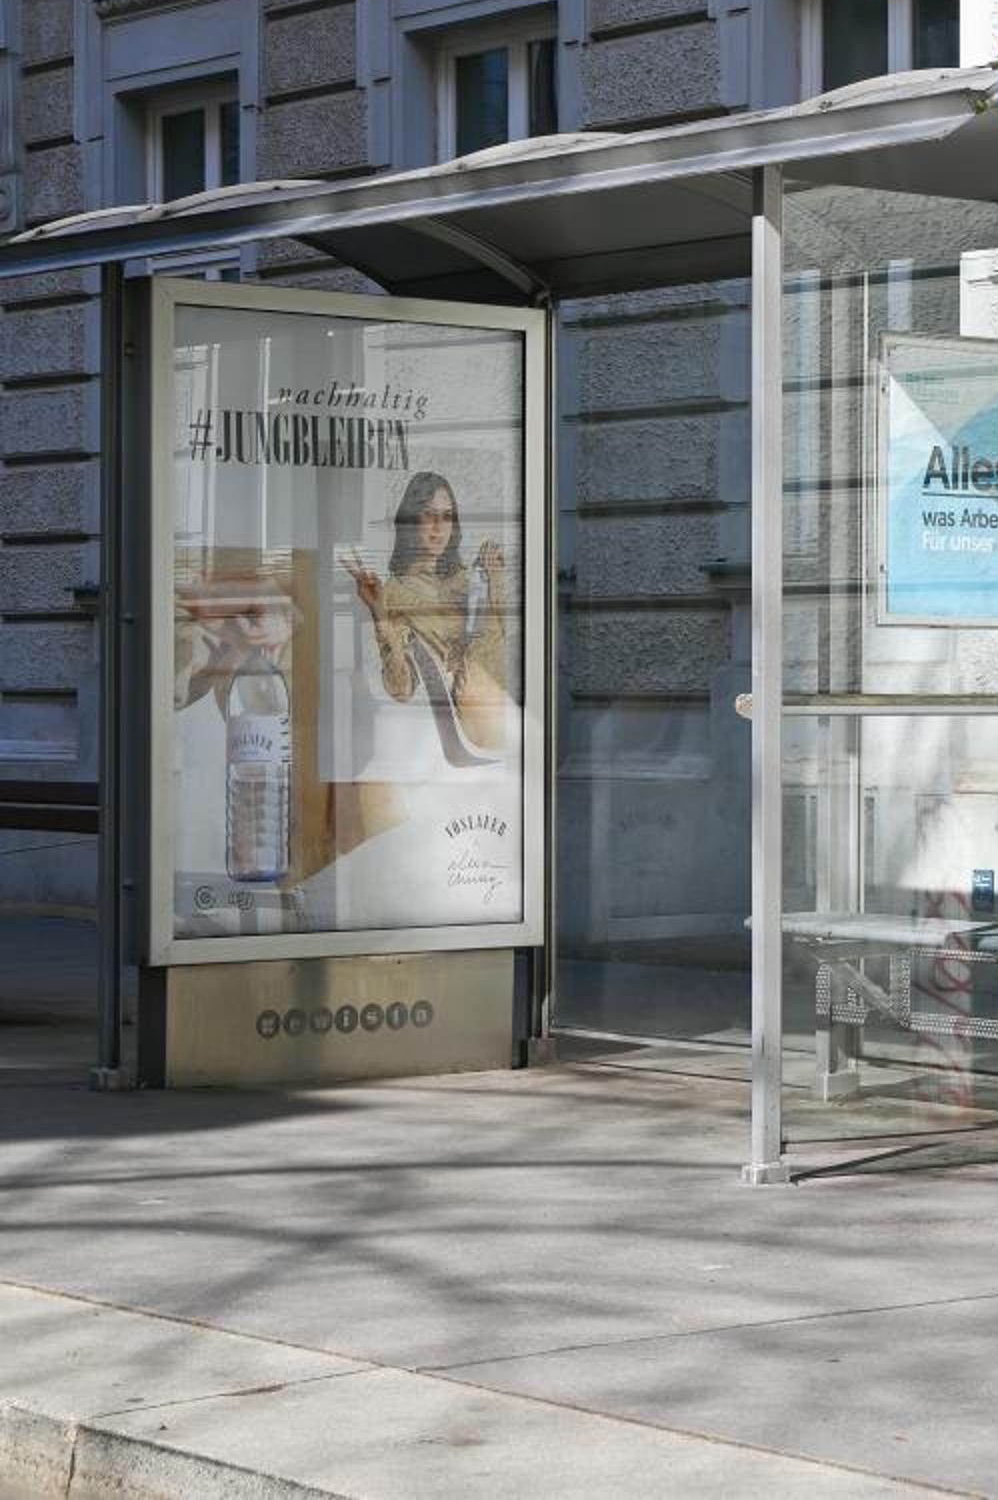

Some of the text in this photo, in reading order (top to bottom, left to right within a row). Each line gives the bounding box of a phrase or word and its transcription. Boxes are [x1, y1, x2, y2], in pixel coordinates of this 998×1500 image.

[277, 381, 430, 421] nachhaltig
[188, 407, 412, 471] #JUNGBLEIBEN
[921, 509, 956, 528] was
